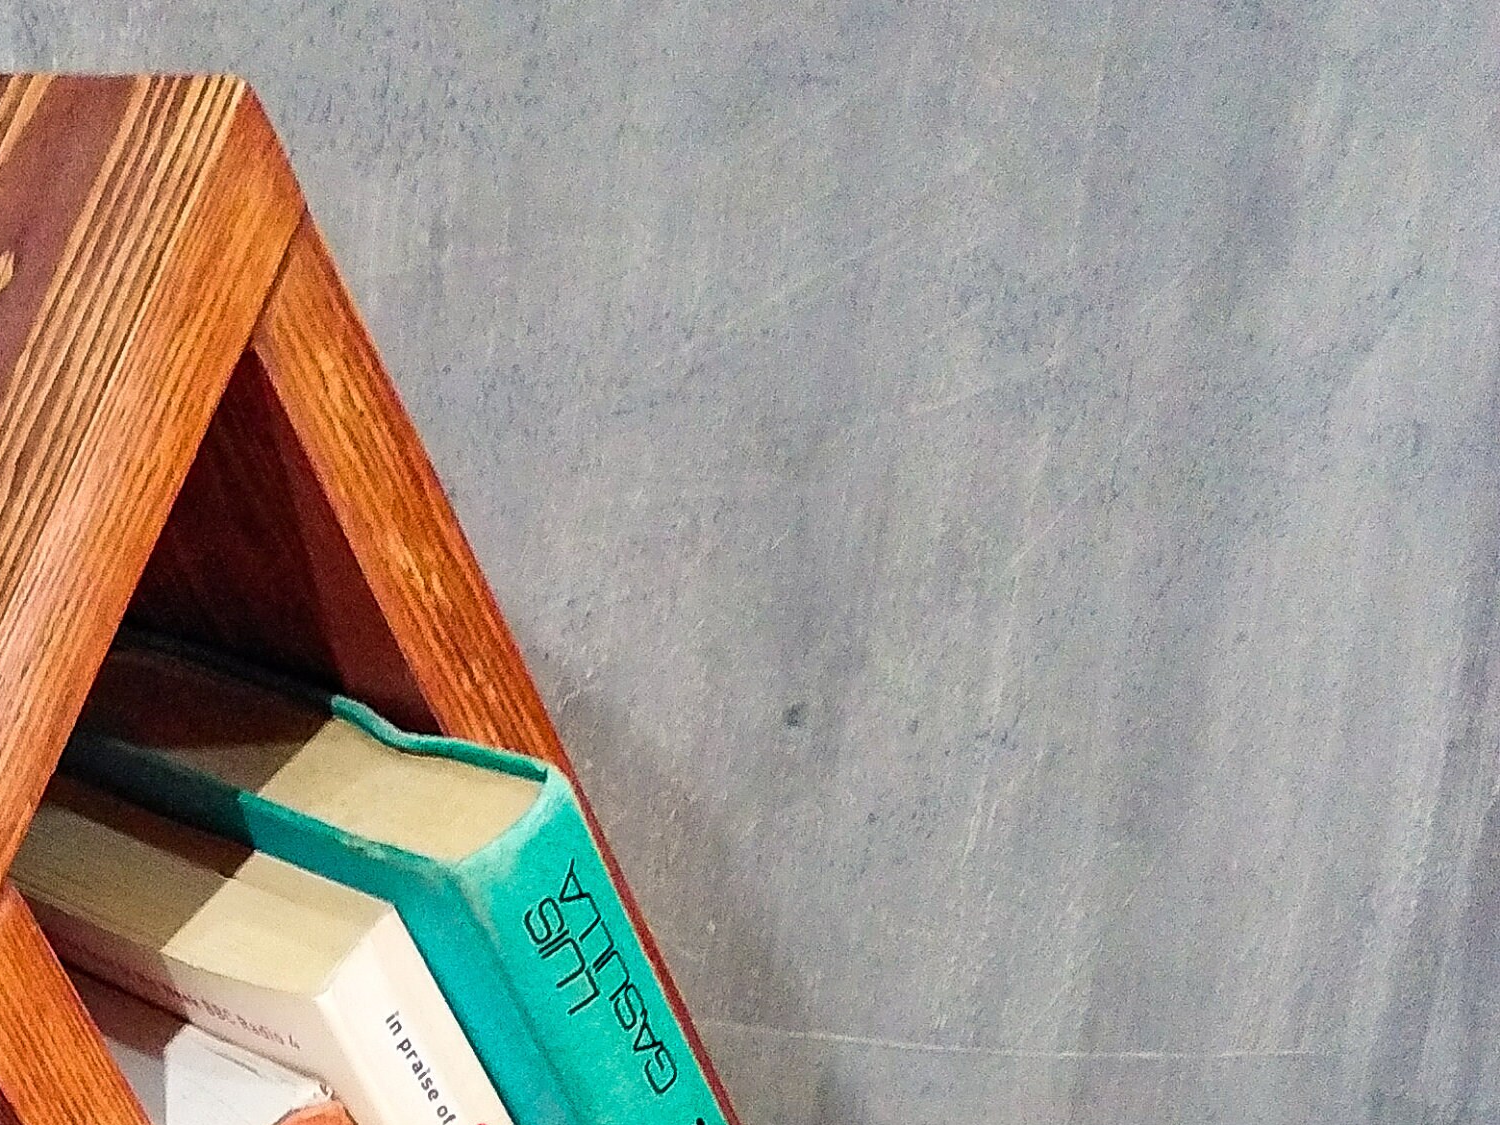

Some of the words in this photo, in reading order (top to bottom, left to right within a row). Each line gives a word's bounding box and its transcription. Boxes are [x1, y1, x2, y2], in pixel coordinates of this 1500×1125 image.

[524, 897, 601, 1016] LUIS
[558, 858, 678, 1095] GASULLA
[385, 1010, 403, 1036] in
[396, 1036, 440, 1103] praise
[436, 1105, 458, 1125] of
